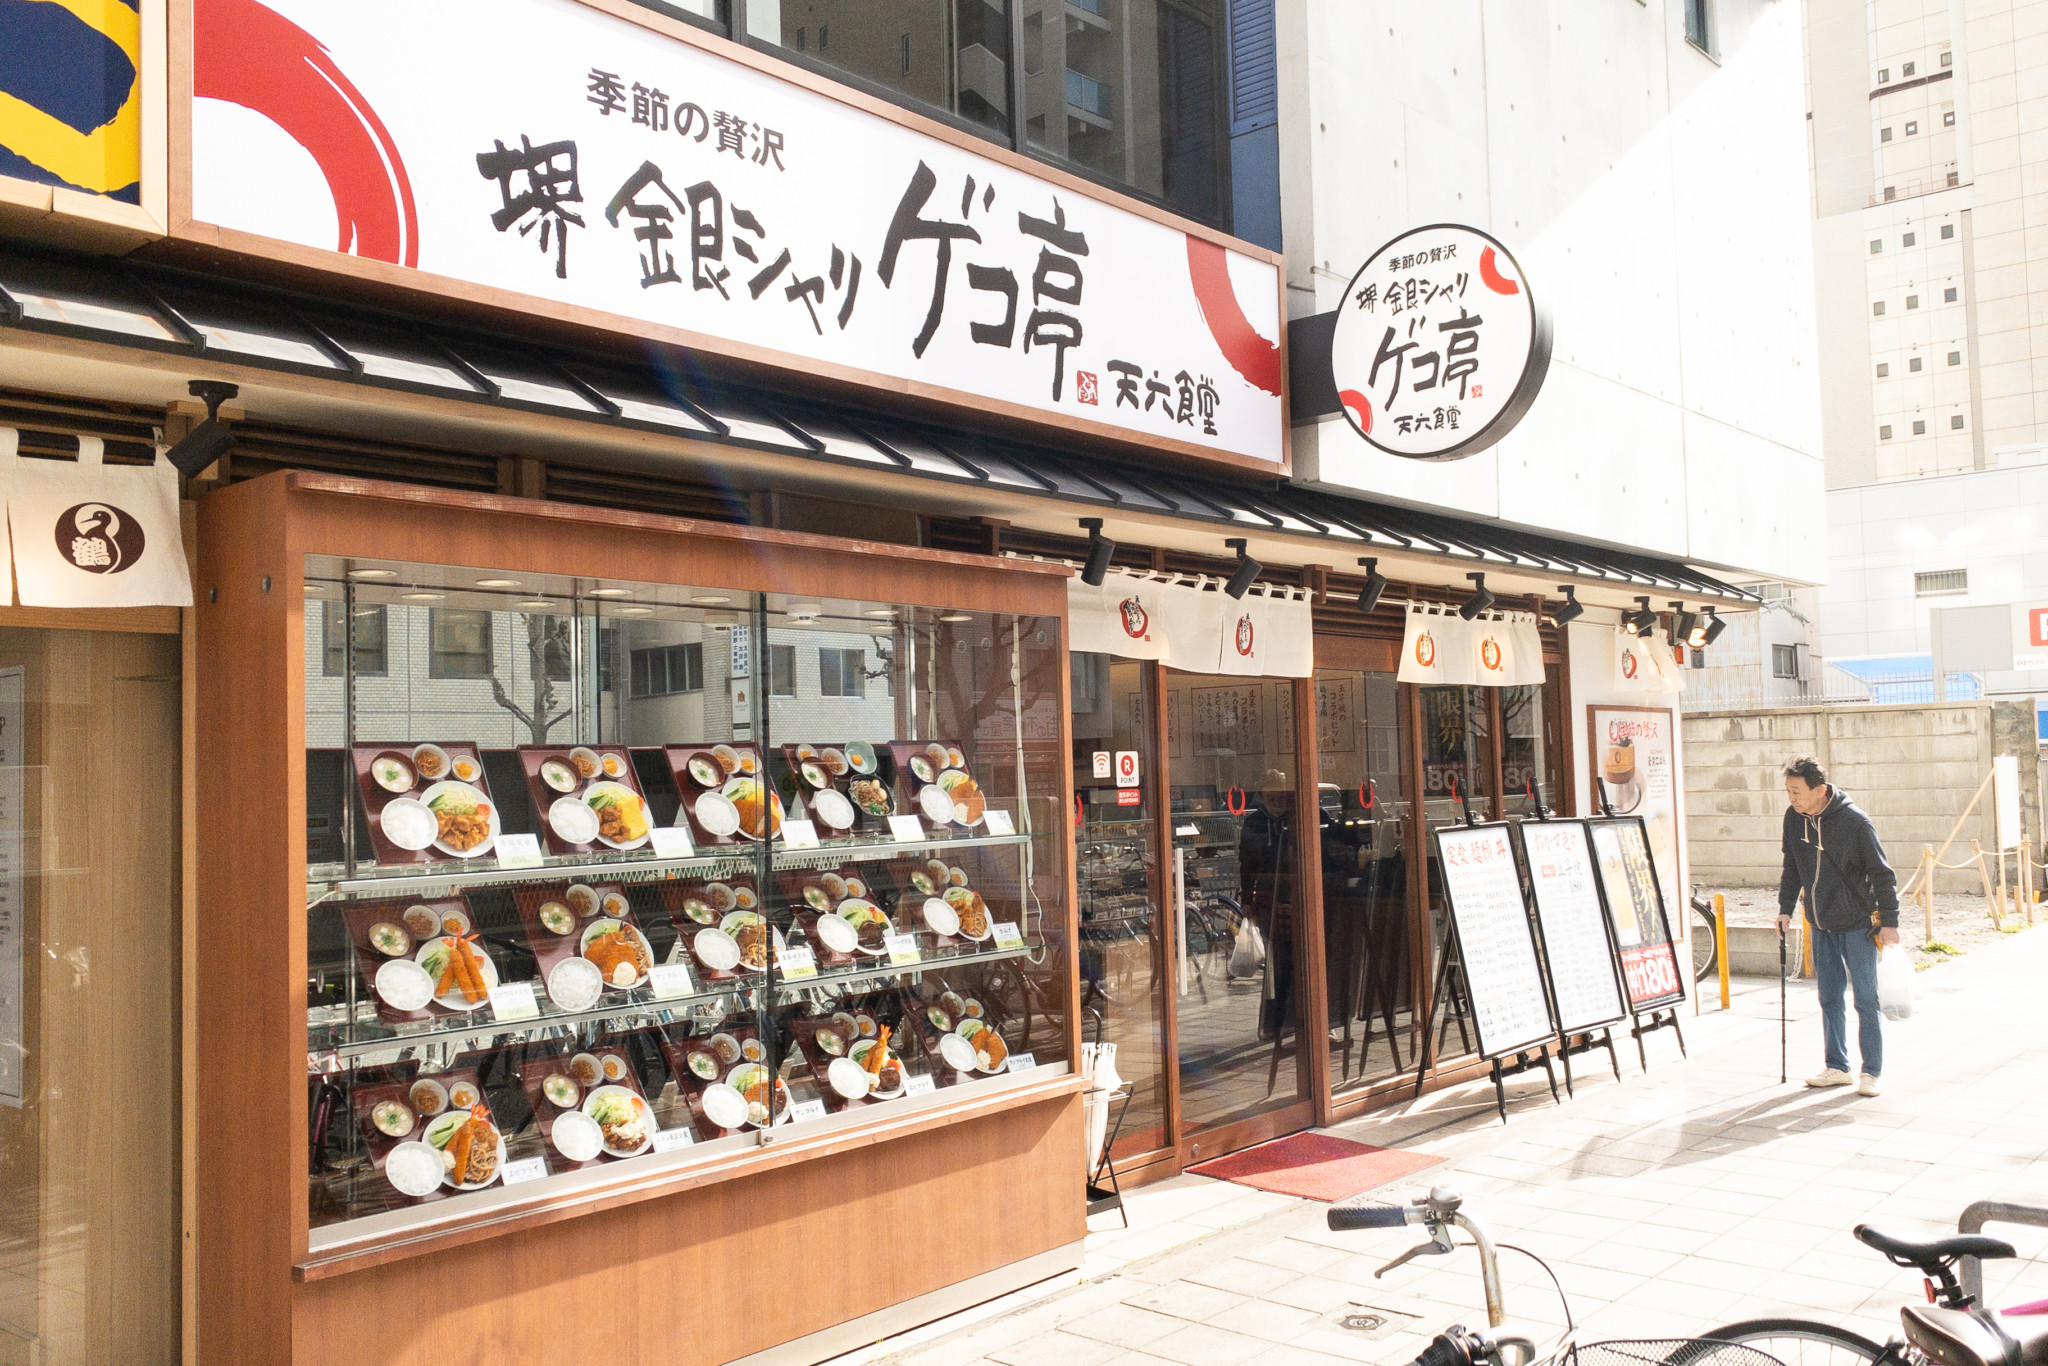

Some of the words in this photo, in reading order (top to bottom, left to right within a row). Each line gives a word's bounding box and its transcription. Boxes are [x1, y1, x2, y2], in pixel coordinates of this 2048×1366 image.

[586, 68, 786, 172] 季節の贅沢
[1388, 244, 1457, 273] 季節の贅沢
[1367, 306, 1484, 412] ゲコ亭
[1106, 359, 1221, 436] 天六食堂
[1394, 405, 1462, 436] 天六食堂
[1638, 957, 1673, 995] 180
[509, 1164, 539, 1178] エビフライ
